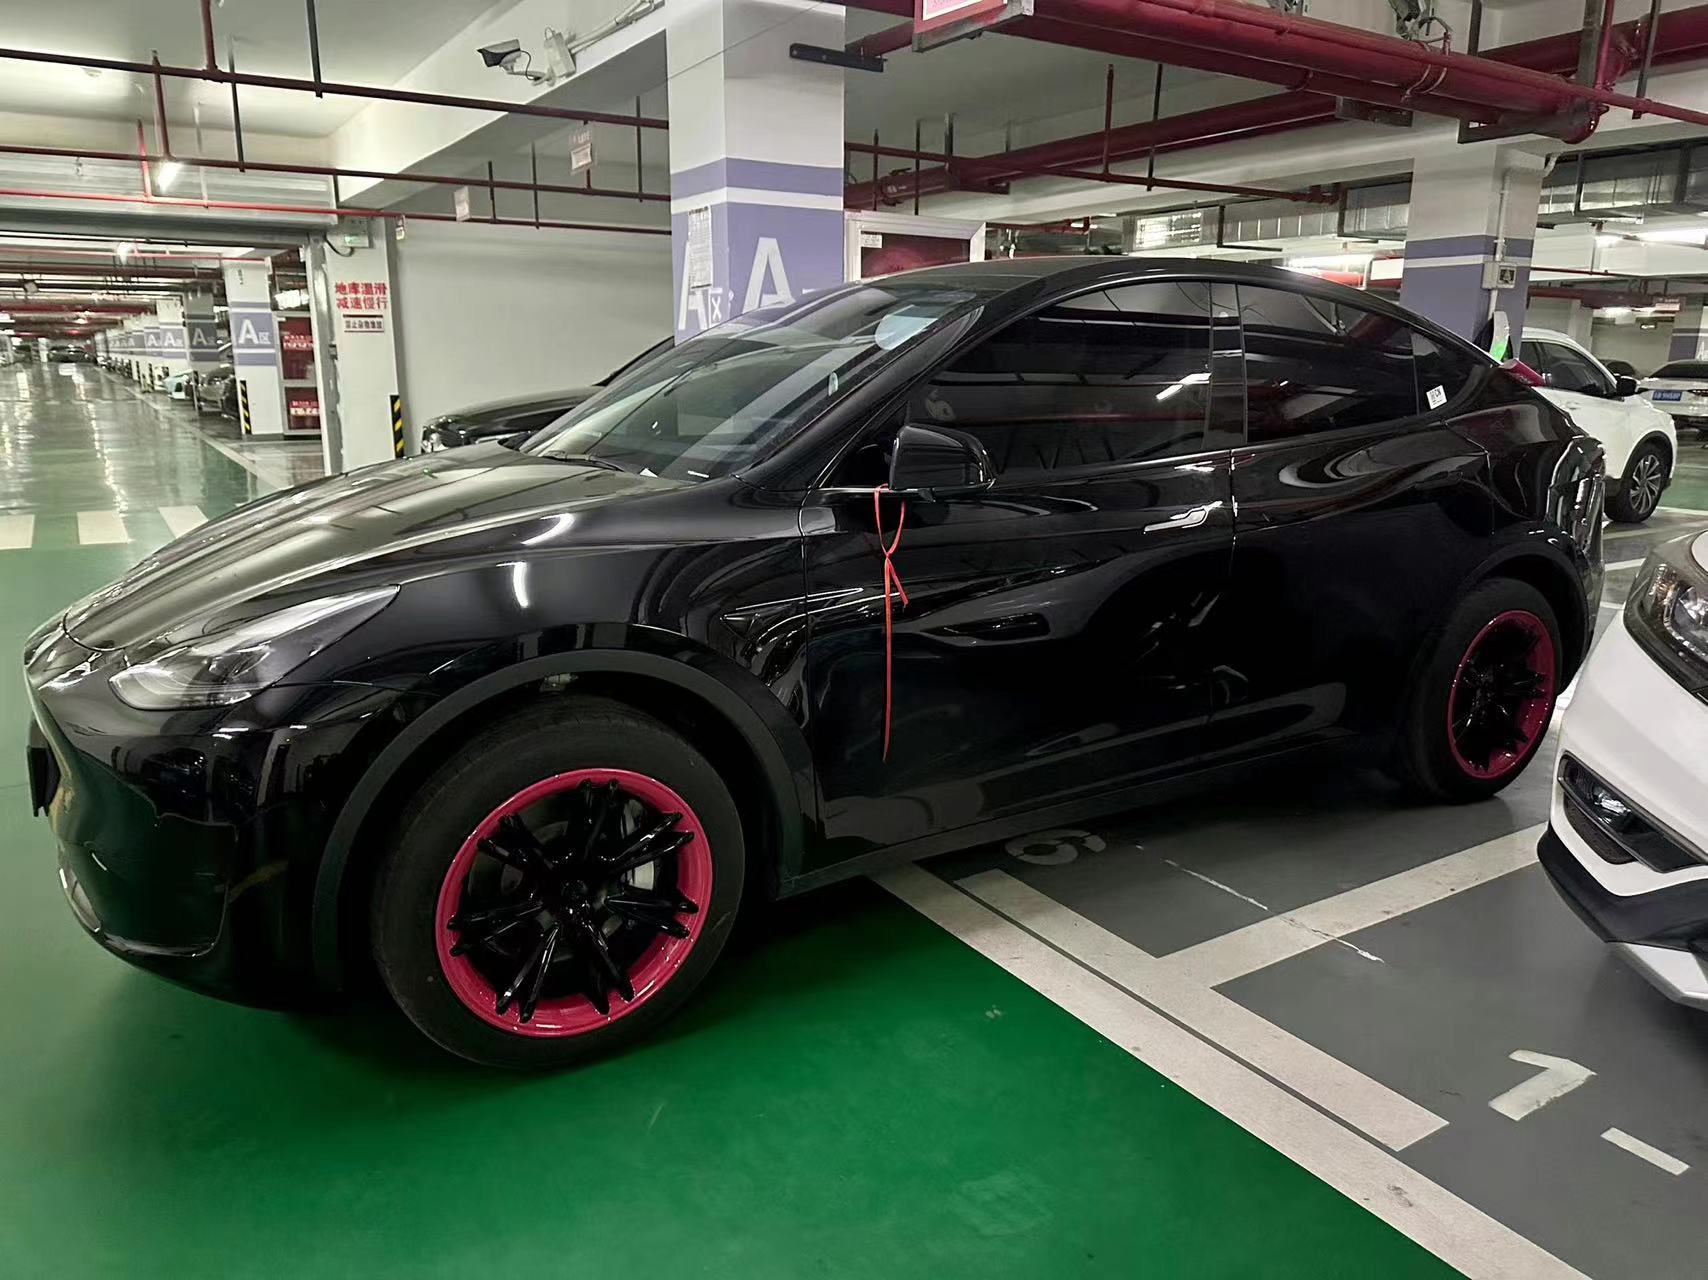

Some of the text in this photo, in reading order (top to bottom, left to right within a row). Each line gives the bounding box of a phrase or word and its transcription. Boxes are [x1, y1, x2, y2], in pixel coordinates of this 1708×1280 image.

[336, 296, 388, 310] 减速慢行
[238, 318, 272, 345] A区
